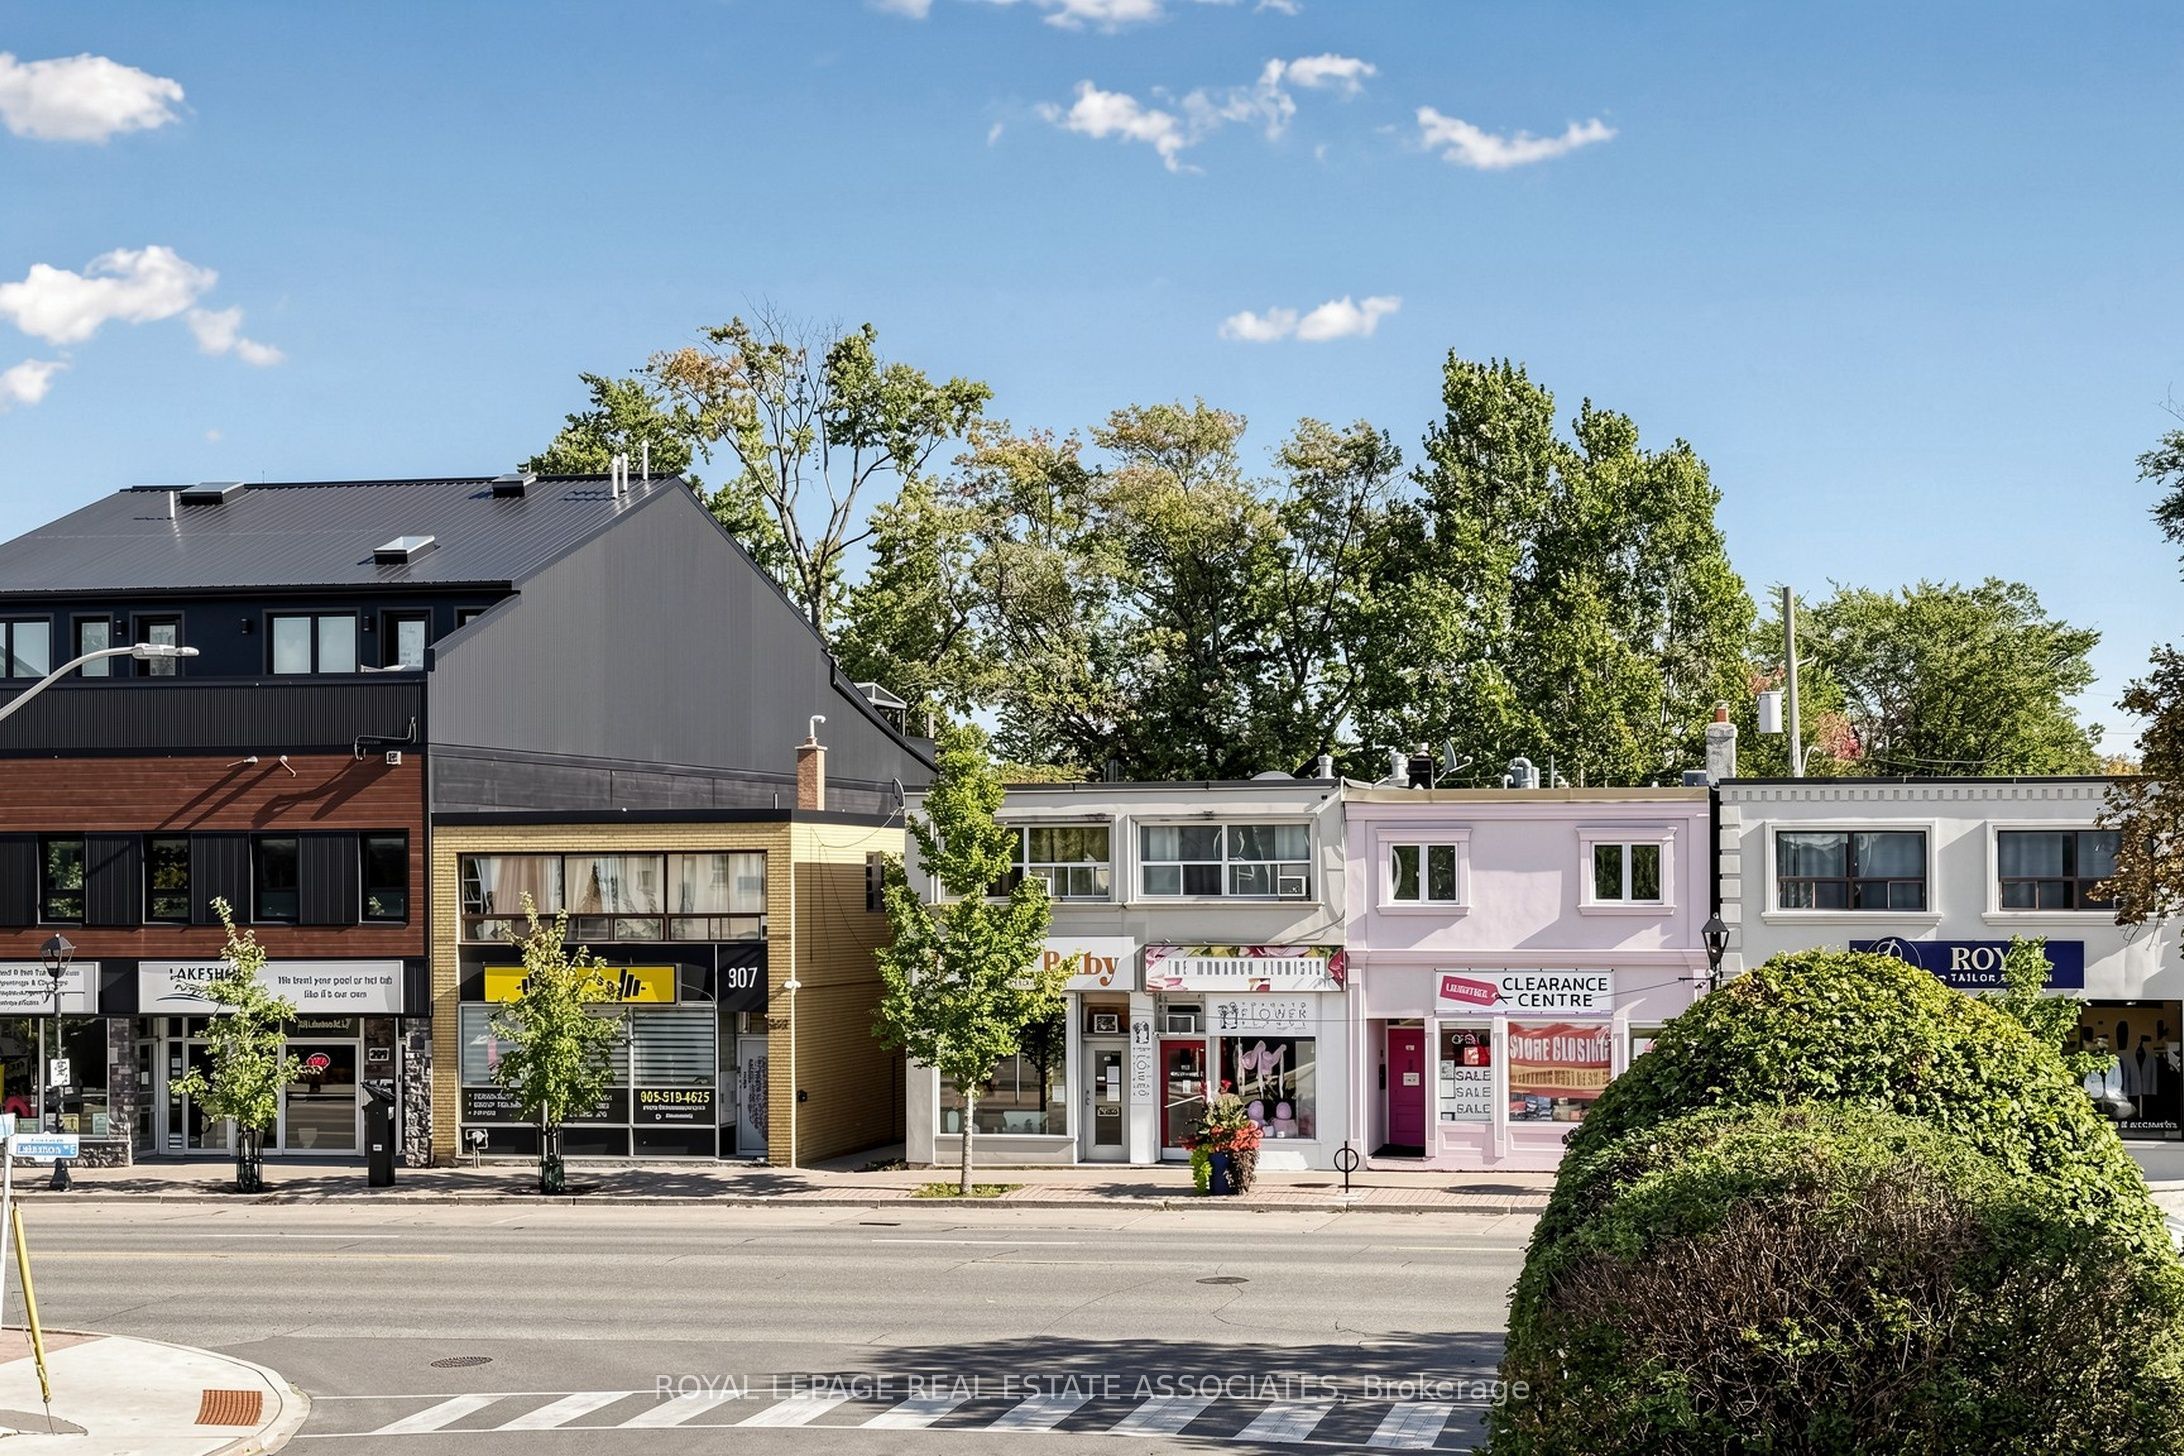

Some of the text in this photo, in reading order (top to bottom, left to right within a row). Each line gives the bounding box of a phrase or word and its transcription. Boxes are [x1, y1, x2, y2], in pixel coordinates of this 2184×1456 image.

[1950, 947, 2036, 970] ROY
[1044, 951, 1119, 987] by
[1502, 977, 1608, 991] CLEARANCE
[1518, 994, 1593, 1007] CENTRE
[1456, 1070, 1491, 1081] SALE
[1456, 1086, 1491, 1098] SALE
[1456, 1103, 1491, 1114] SALE
